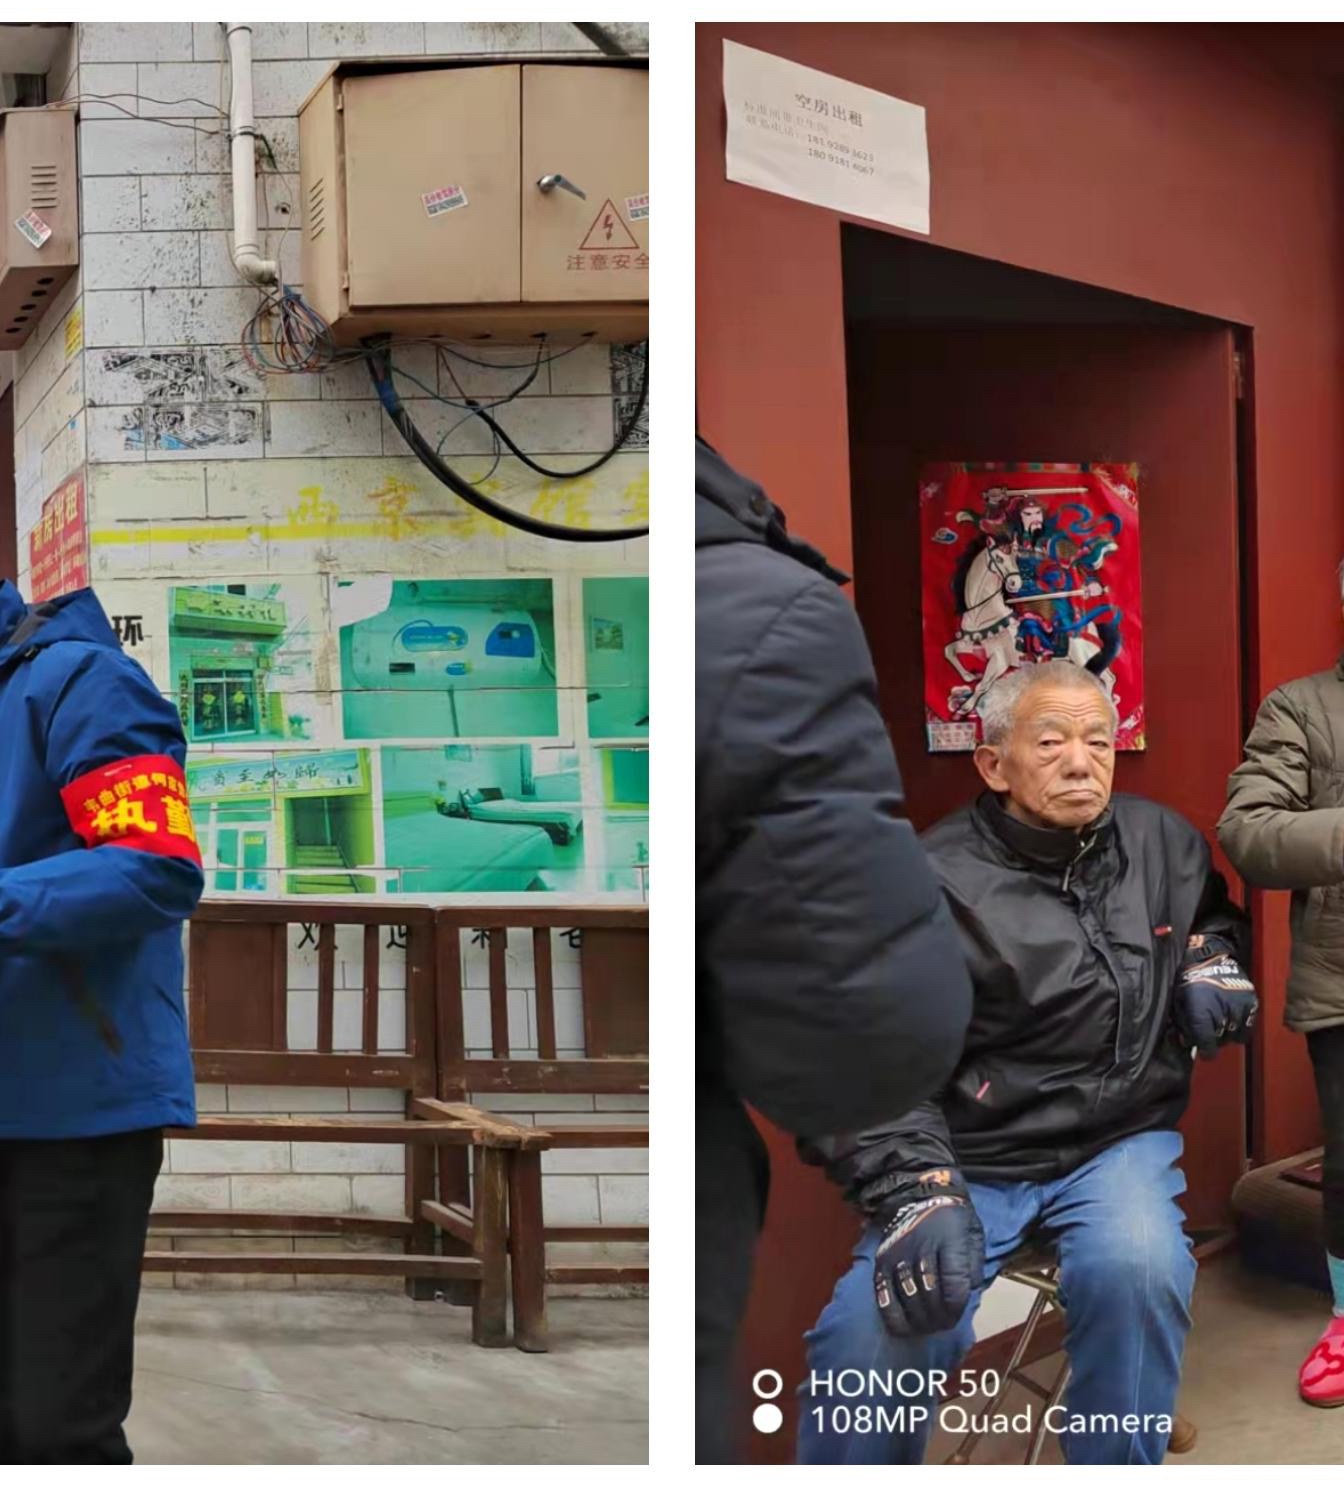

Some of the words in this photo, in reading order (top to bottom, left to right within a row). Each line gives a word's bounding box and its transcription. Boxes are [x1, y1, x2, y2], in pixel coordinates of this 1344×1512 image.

[794, 93, 863, 128] 空房出租
[567, 253, 649, 271] 注意安全
